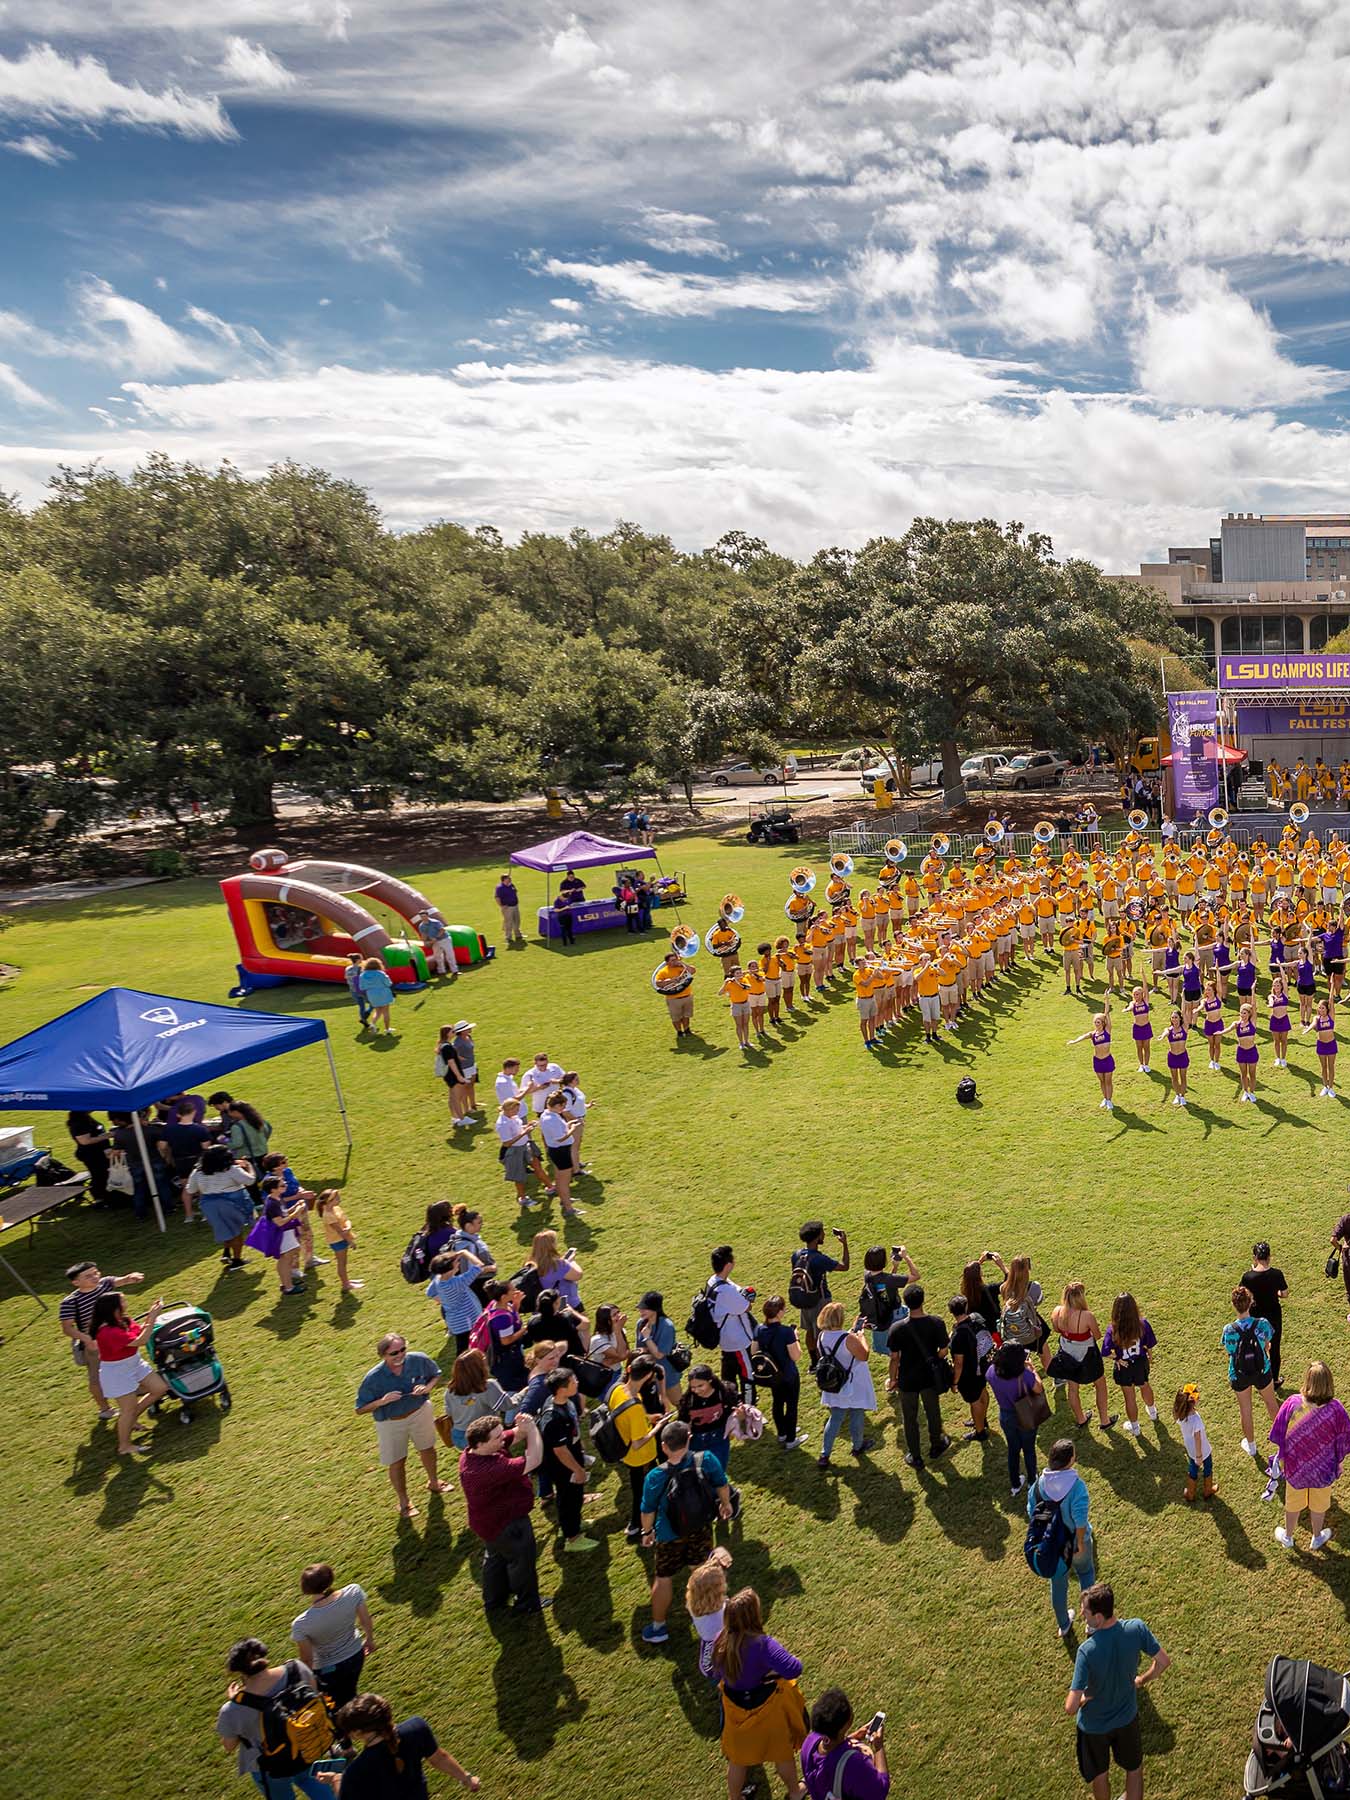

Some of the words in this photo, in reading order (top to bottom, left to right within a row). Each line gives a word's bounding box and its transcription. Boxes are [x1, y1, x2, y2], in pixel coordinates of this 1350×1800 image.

[1226, 664, 1269, 680] LSU
[1272, 663, 1324, 679] CAMPUS
[1326, 662, 1350, 678] LIFE
[1299, 701, 1345, 716] LSU
[1289, 719, 1320, 729] FALL
[577, 912, 600, 922] LSU
[155, 1018, 208, 1039] TOPGOLF
[0, 1092, 48, 1103] golf.com
